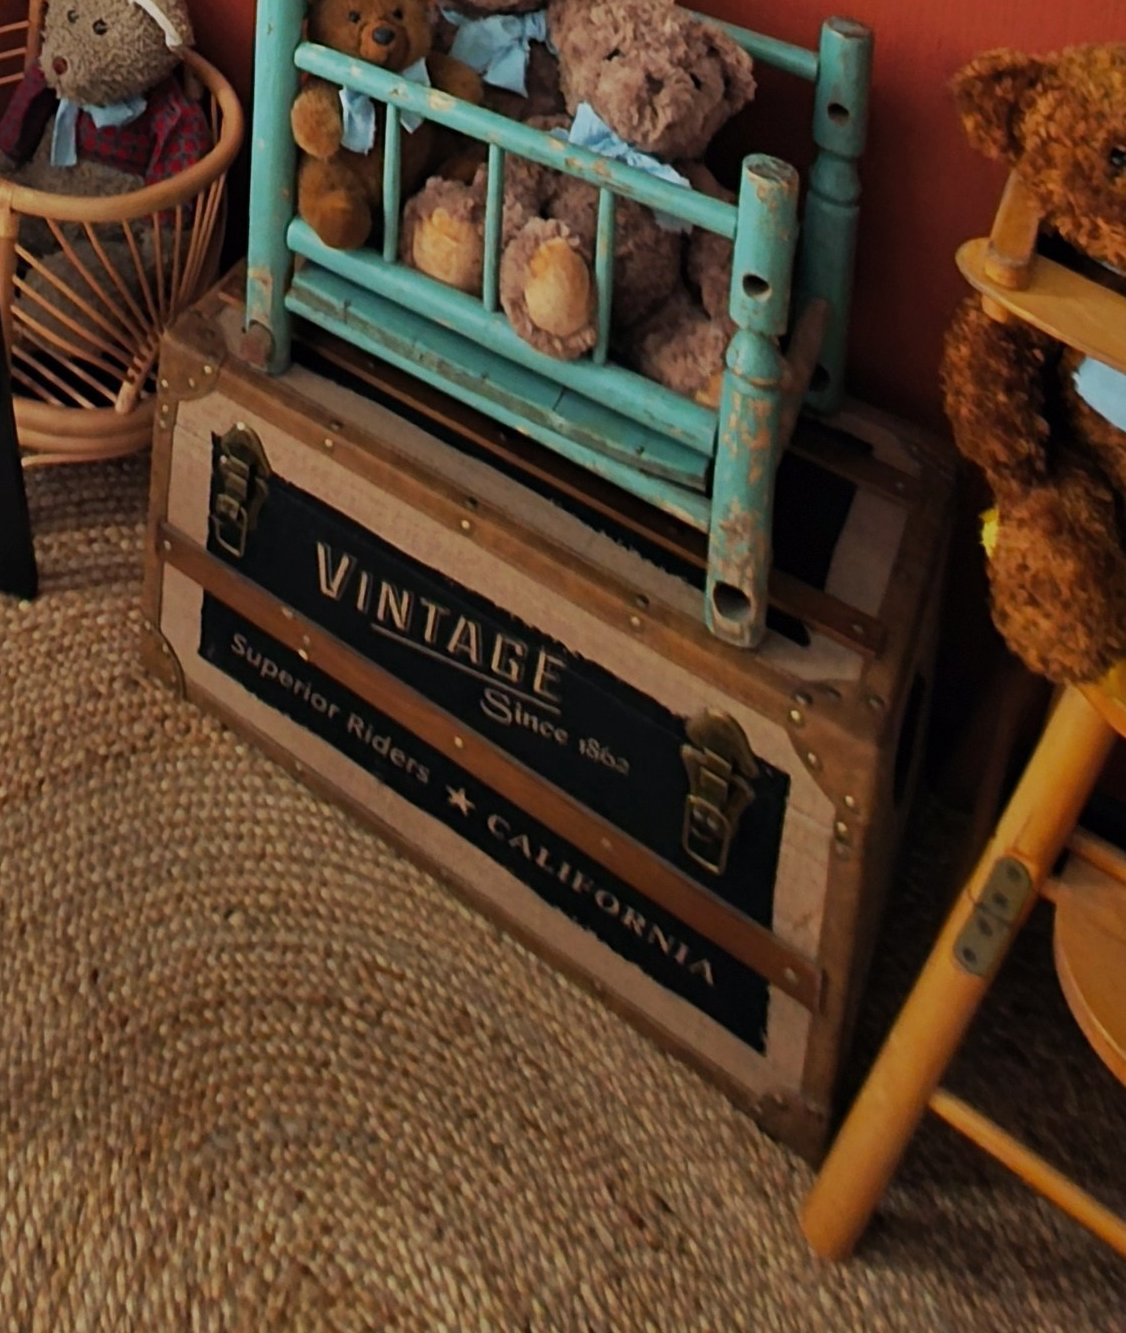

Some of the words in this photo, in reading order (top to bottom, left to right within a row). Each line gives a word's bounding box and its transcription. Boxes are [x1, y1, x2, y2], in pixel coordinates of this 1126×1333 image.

[317, 541, 568, 703] VINTAGE
[480, 687, 569, 746] Since
[231, 633, 340, 719] Superior
[347, 713, 431, 783] Riders
[487, 814, 714, 986] CALIFORNIA
